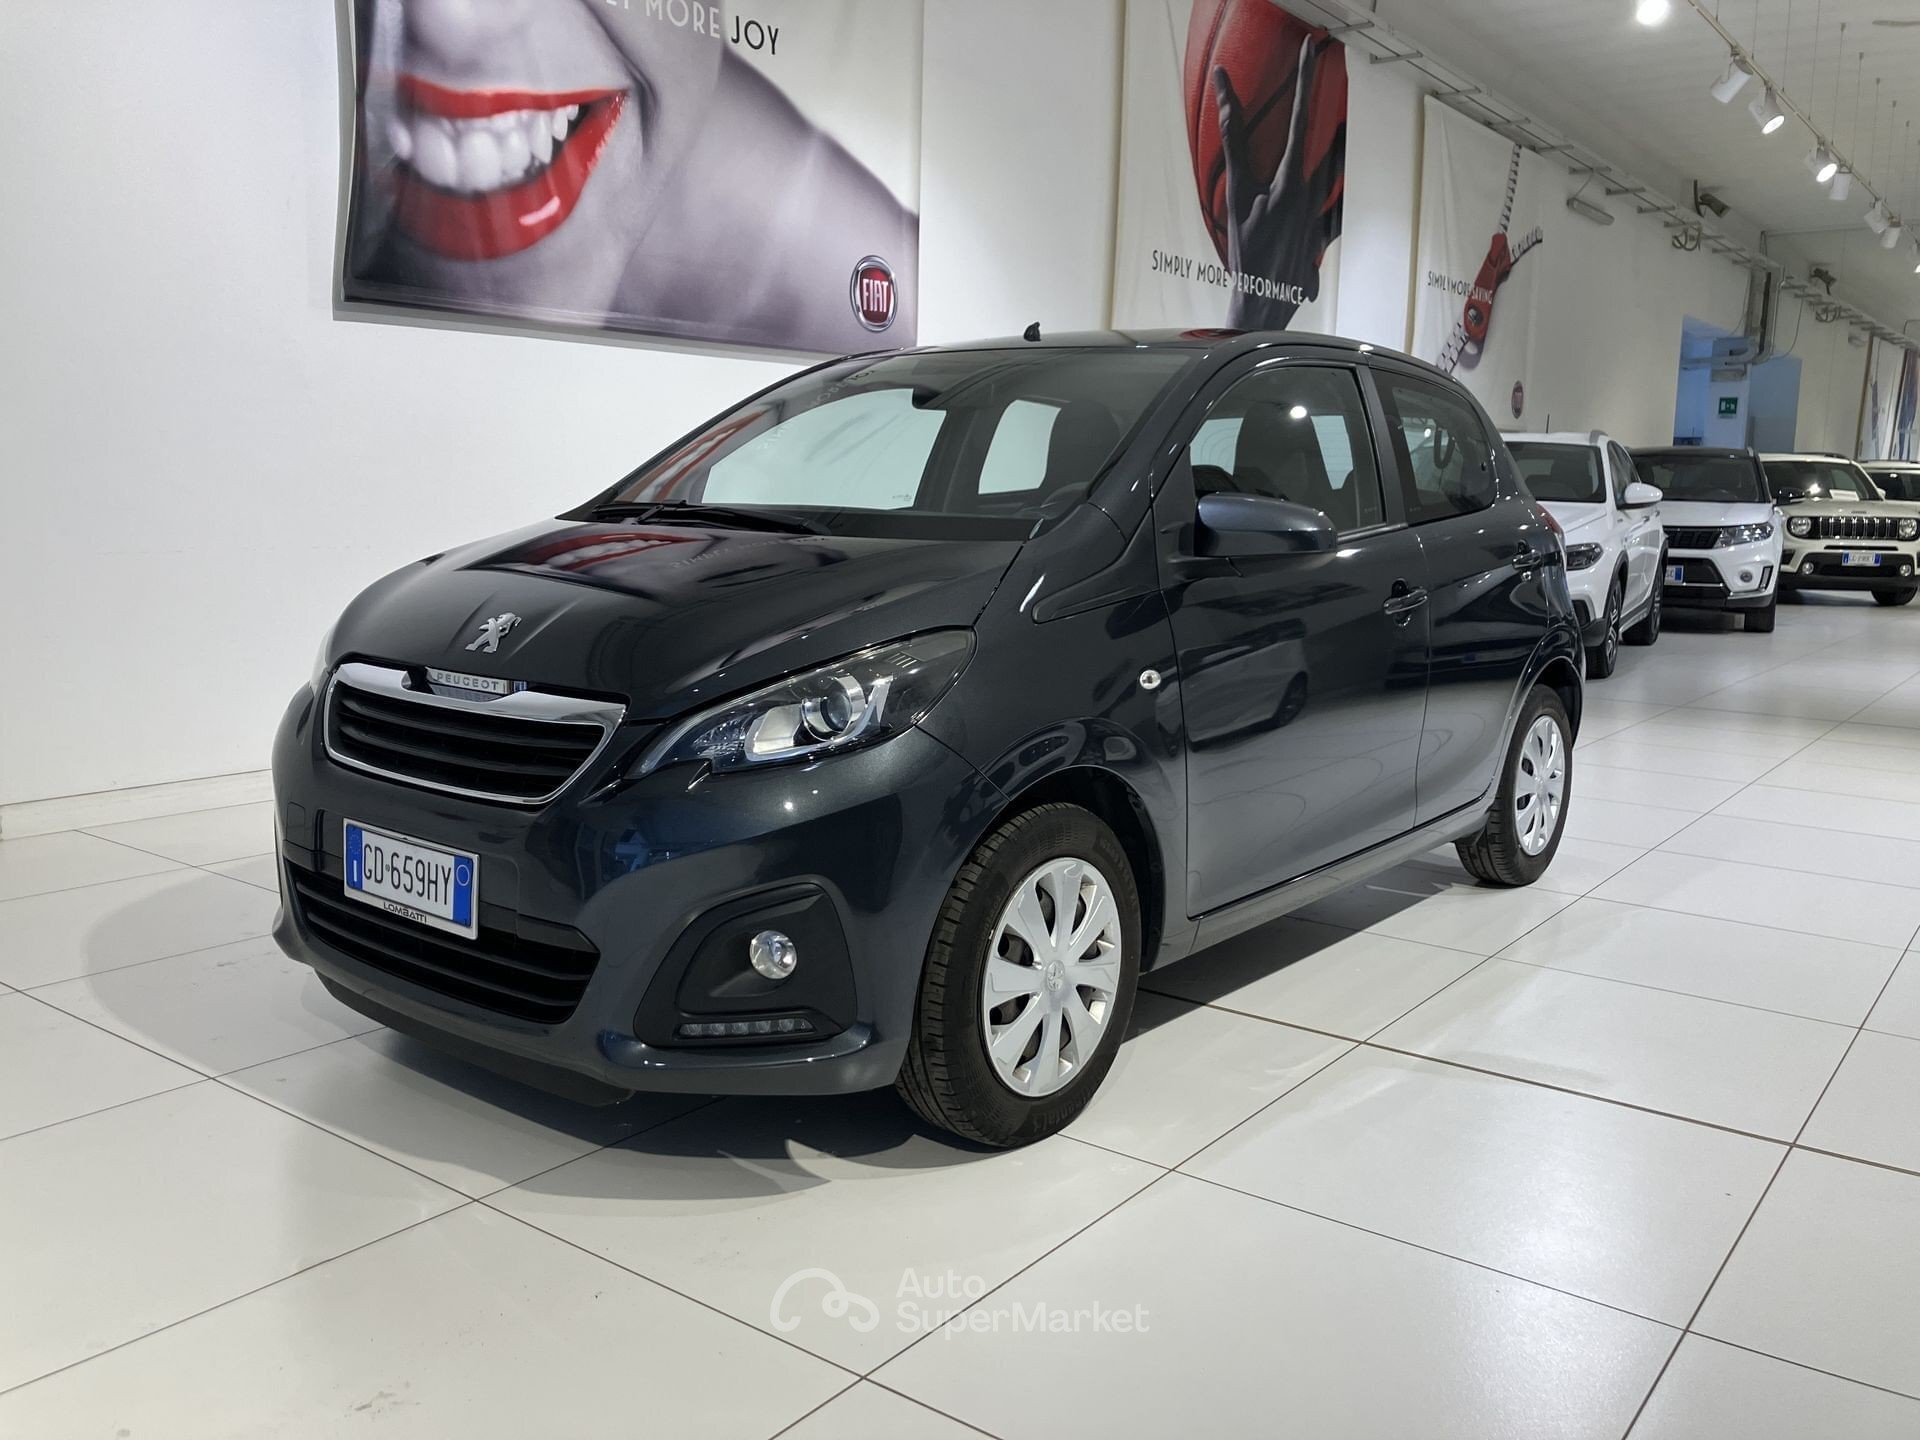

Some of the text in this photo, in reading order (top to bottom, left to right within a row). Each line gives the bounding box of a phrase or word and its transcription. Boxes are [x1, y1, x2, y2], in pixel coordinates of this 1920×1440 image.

[731, 15, 779, 55] JOY
[1152, 249, 1304, 305] SIMPLY MORE PERFORMANCE
[862, 278, 889, 313] FIAT
[437, 672, 499, 691] PEUGEOT
[383, 901, 428, 925] LOMBATTI
